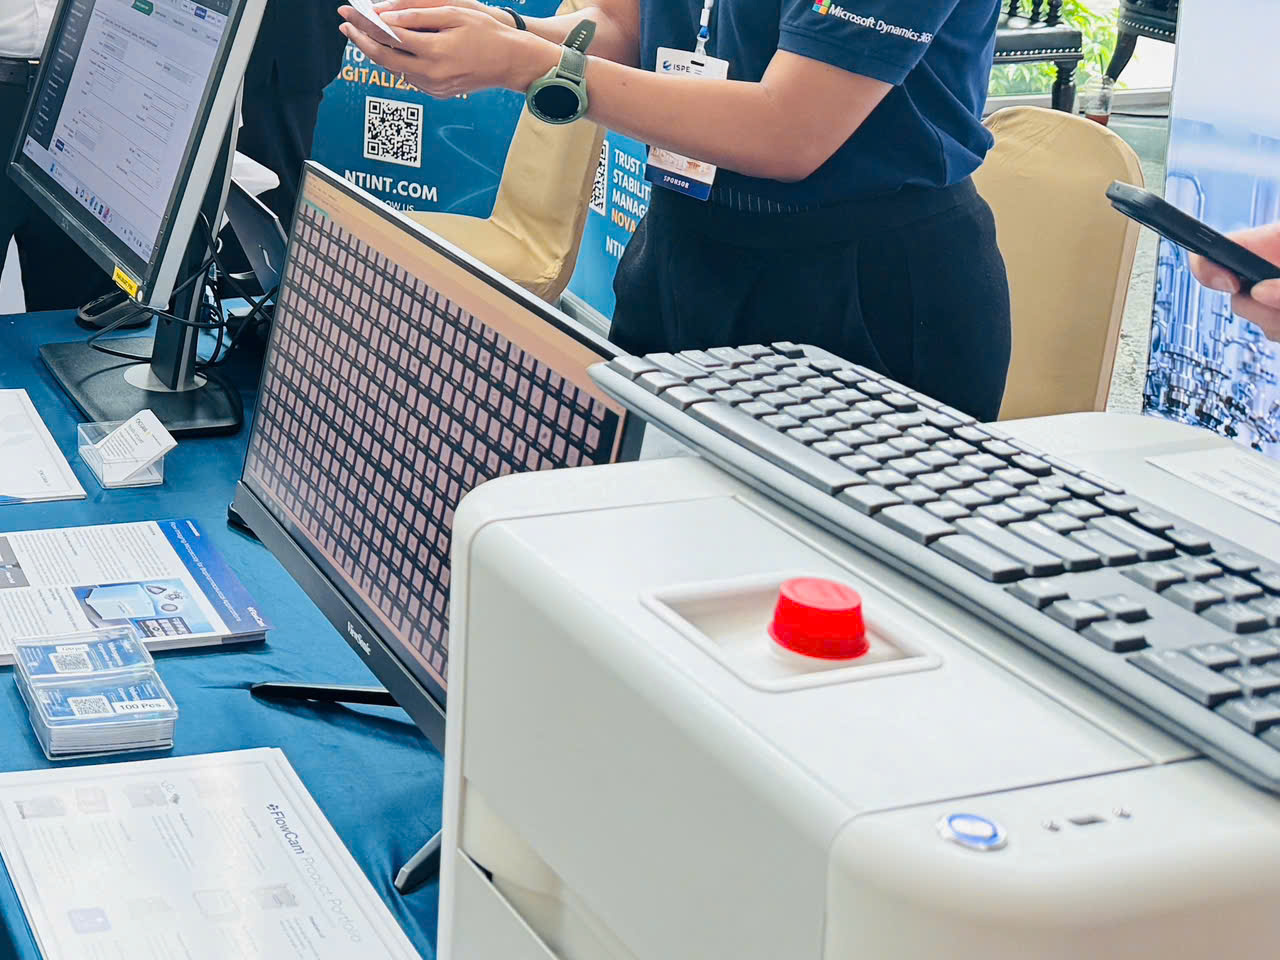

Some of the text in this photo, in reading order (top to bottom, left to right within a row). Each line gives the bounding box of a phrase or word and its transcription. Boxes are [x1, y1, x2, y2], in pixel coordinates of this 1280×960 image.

[828, 3, 875, 29] Microsoft
[875, 19, 919, 41] Dynamics
[345, 46, 365, 62] TO
[673, 64, 691, 73] ISPE
[614, 148, 641, 175] TRUST
[344, 170, 438, 203] NTINT.COM
[613, 169, 652, 201] STABILIT
[663, 175, 690, 189] SPONSOR
[612, 188, 648, 219] MANAG
[611, 208, 637, 233] NOVA
[120, 703, 139, 711] 100
[270, 809, 305, 855] FlowCam
